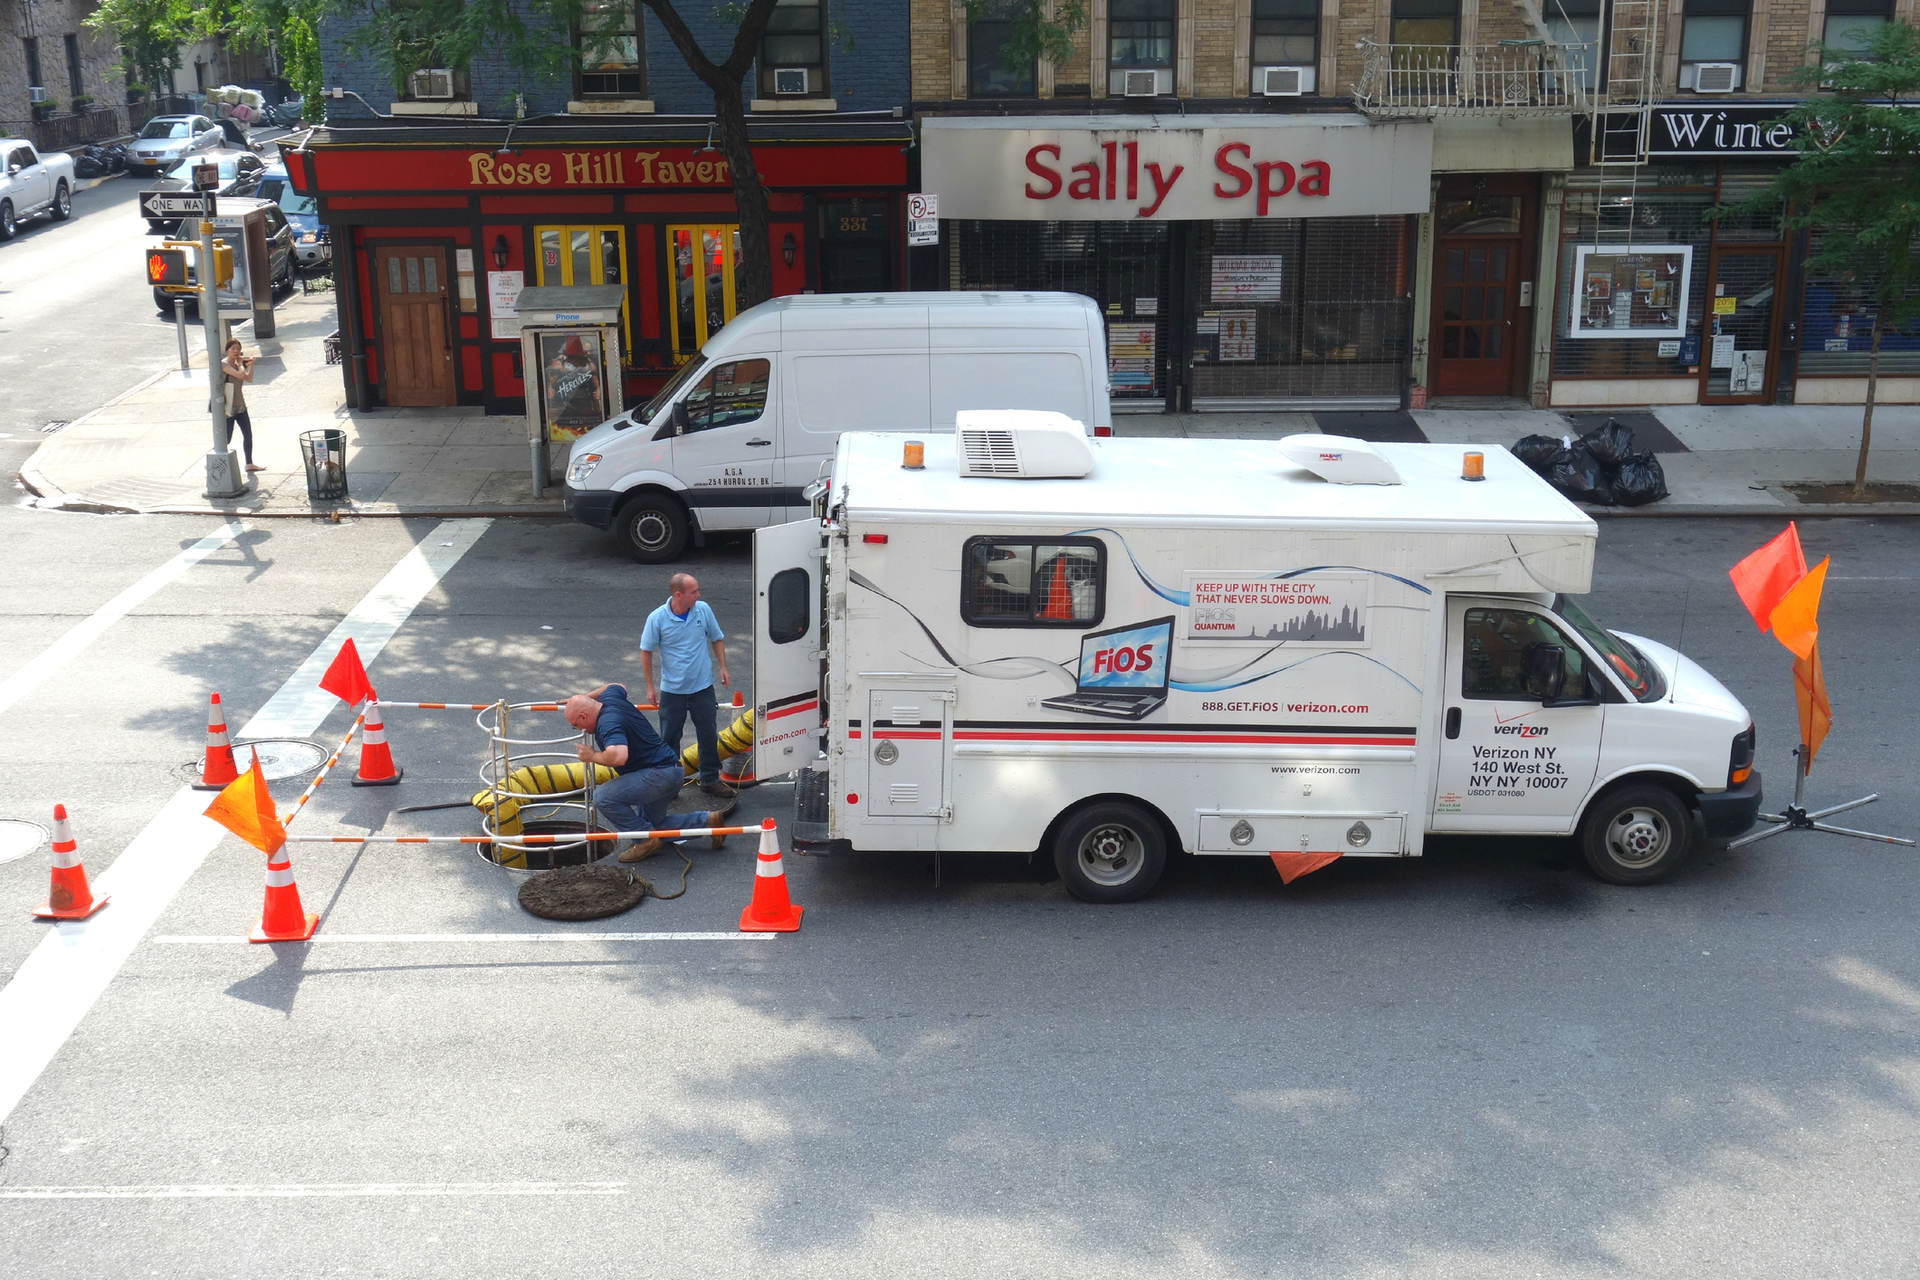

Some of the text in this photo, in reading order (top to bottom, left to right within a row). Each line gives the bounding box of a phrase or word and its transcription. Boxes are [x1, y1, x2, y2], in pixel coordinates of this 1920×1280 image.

[1660, 111, 1793, 148] Wine
[468, 151, 728, 185] Rose Hill Taver
[1025, 141, 1331, 217] Sally Spa
[151, 200, 204, 210] ONE WAY
[840, 217, 868, 231] 337
[1716, 298, 1735, 306] 20%
[555, 313, 580, 321] Phone
[708, 478, 722, 486] 254
[723, 478, 746, 486] HURON
[747, 478, 759, 486] ST.
[760, 477, 770, 485] BK
[1196, 583, 1316, 593] KEEP UP WITH THE CITY
[1196, 594, 1332, 605] THAT NEVER SLOWS DOWN.
[1194, 608, 1236, 623] FiOS
[1194, 623, 1235, 631] QUANTUM
[1093, 644, 1154, 674] FiOS
[1201, 701, 1279, 712] 888.GET.FiOS
[1286, 701, 1369, 713] verizon.com
[1493, 723, 1549, 738] verizon
[759, 728, 807, 746] verizon.com
[1472, 745, 1557, 759] Verizon NY
[1270, 765, 1361, 775] www.verizon.com
[1472, 761, 1565, 774] 140 West St.
[1469, 775, 1569, 789] NY NY 10007
[1467, 789, 1496, 797] USDOT
